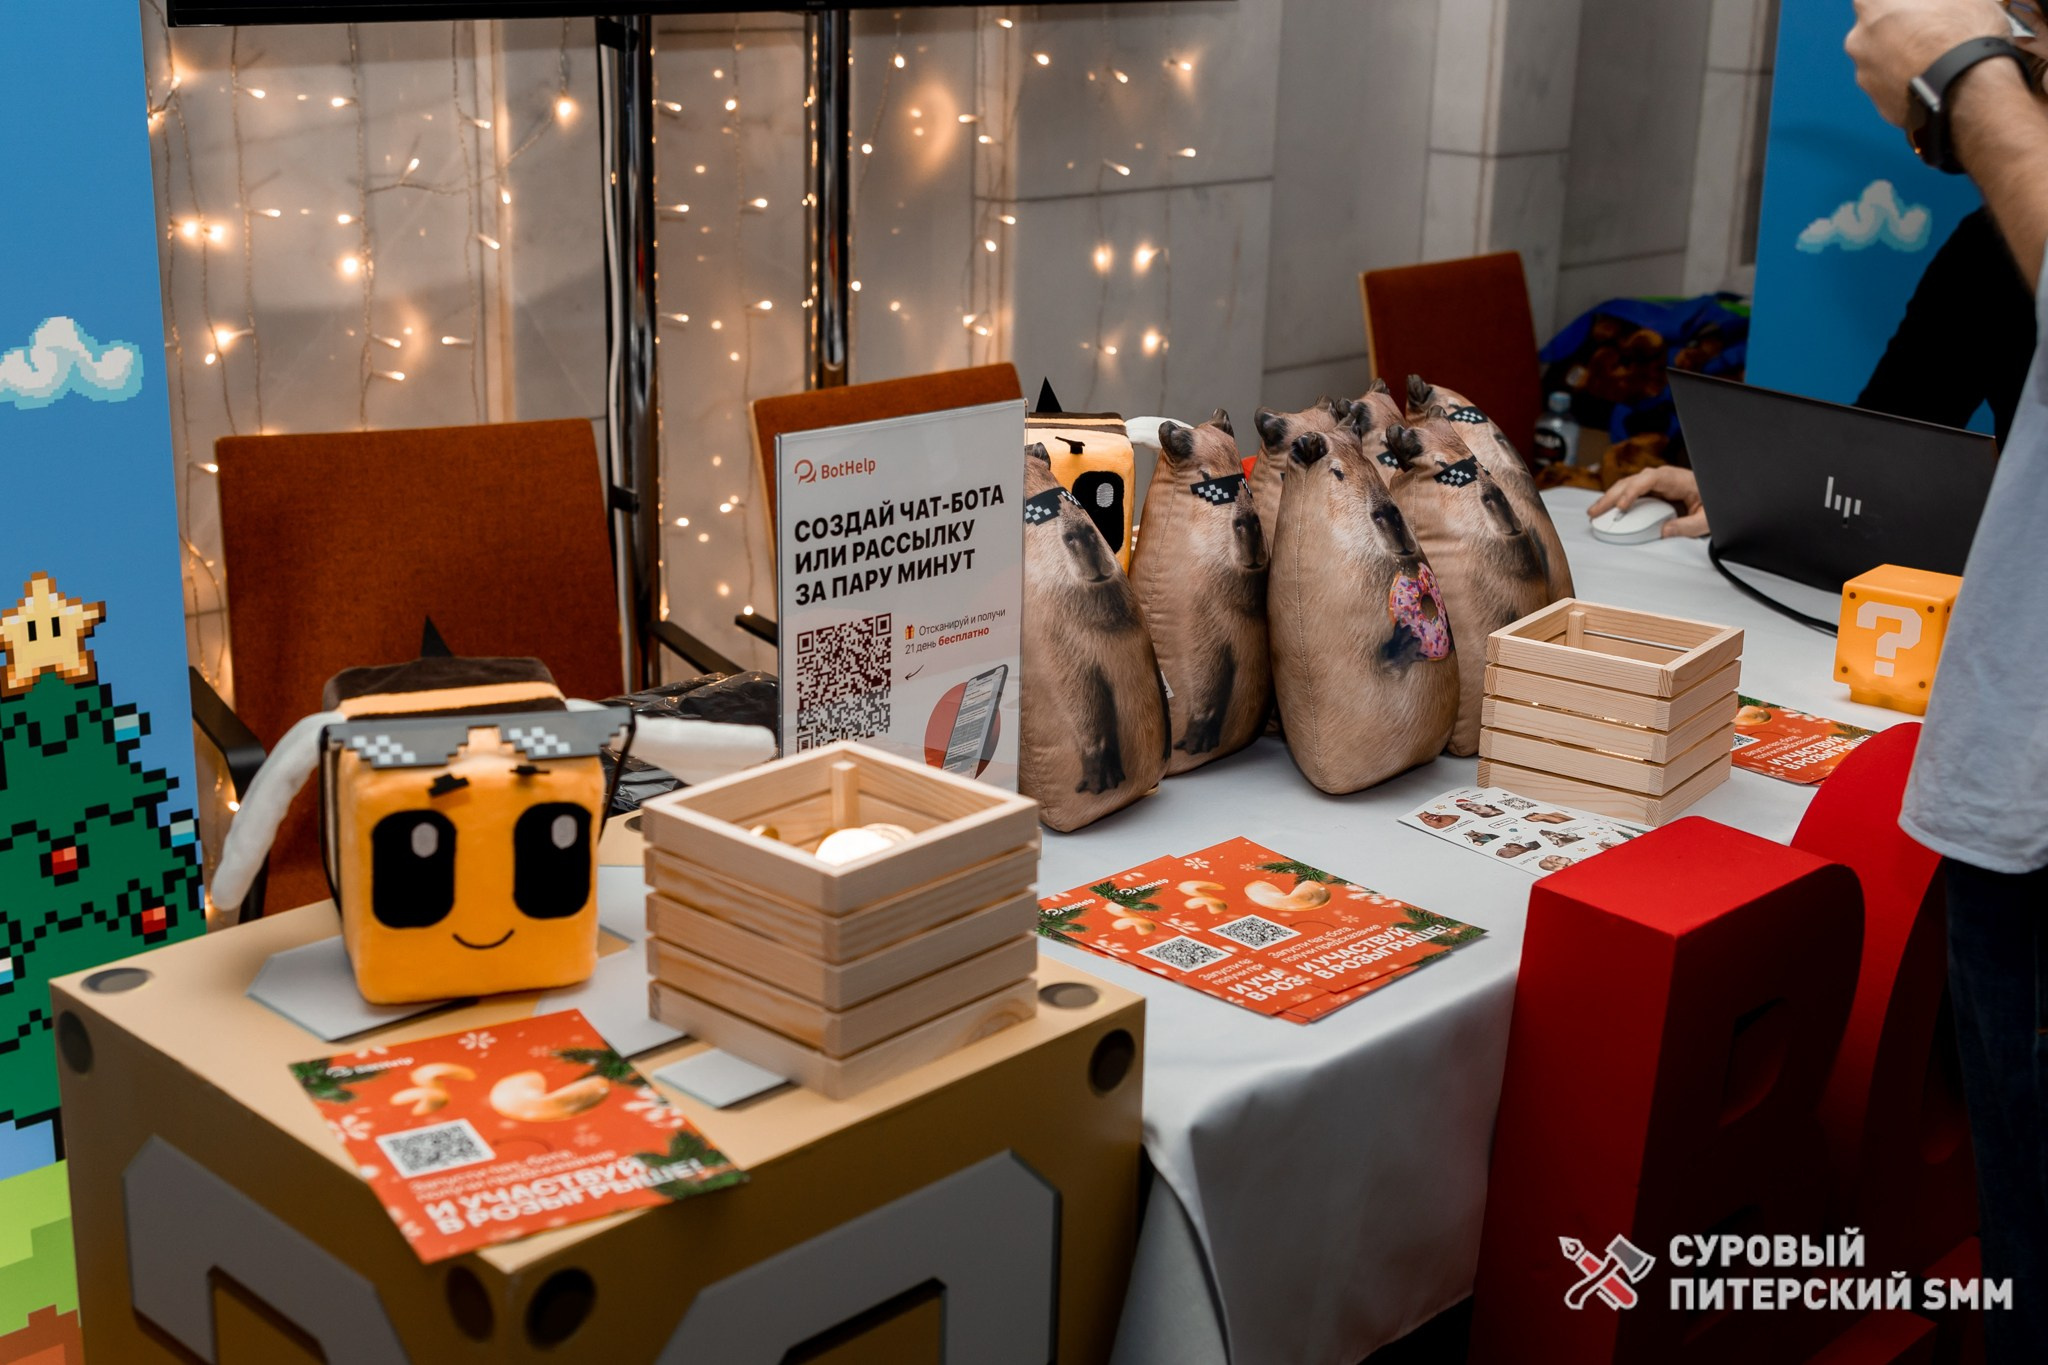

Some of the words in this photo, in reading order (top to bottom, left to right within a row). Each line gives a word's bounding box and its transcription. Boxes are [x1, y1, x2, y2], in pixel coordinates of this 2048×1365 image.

[821, 458, 876, 480] BotHelp
[794, 500, 894, 543] СОЗДАЙ
[900, 484, 1005, 522] ЧАТ-БОТА
[795, 545, 847, 574] ИЛИ
[852, 519, 975, 563] РАССЫЛКУ
[795, 580, 827, 606] ЗА
[832, 565, 894, 598] ПАРУ
[898, 549, 975, 584] МИНУТ
[919, 616, 969, 636] Отсканируй
[970, 616, 976, 624] и
[978, 609, 1006, 622] получи
[905, 643, 915, 655] 21
[916, 641, 936, 653] день
[938, 627, 989, 646] бесплатно
[1767, 757, 1787, 766] И
[1779, 736, 1848, 762] УЧАСТВУЙ
[1268, 939, 1310, 959] Запусти
[1309, 927, 1355, 947] чат-бота,
[1281, 945, 1317, 963] получи
[1316, 924, 1381, 952] предсказание
[1296, 959, 1320, 973] И
[1311, 926, 1412, 966] УЧАСТВУЙ
[1313, 968, 1336, 980] В
[1328, 924, 1452, 974] РОЗЫГРЫШЕ!
[1198, 960, 1241, 981] Запусти
[1227, 983, 1252, 995] И
[1243, 968, 1285, 988] УЧА
[1245, 991, 1269, 1002] В
[1260, 974, 1306, 996] РОЗ
[425, 1200, 458, 1221] И
[458, 1155, 647, 1209] УЧАСТВУЙ
[436, 1216, 465, 1235] В
[465, 1158, 704, 1228] РОЗЫГРЫШЕ!
